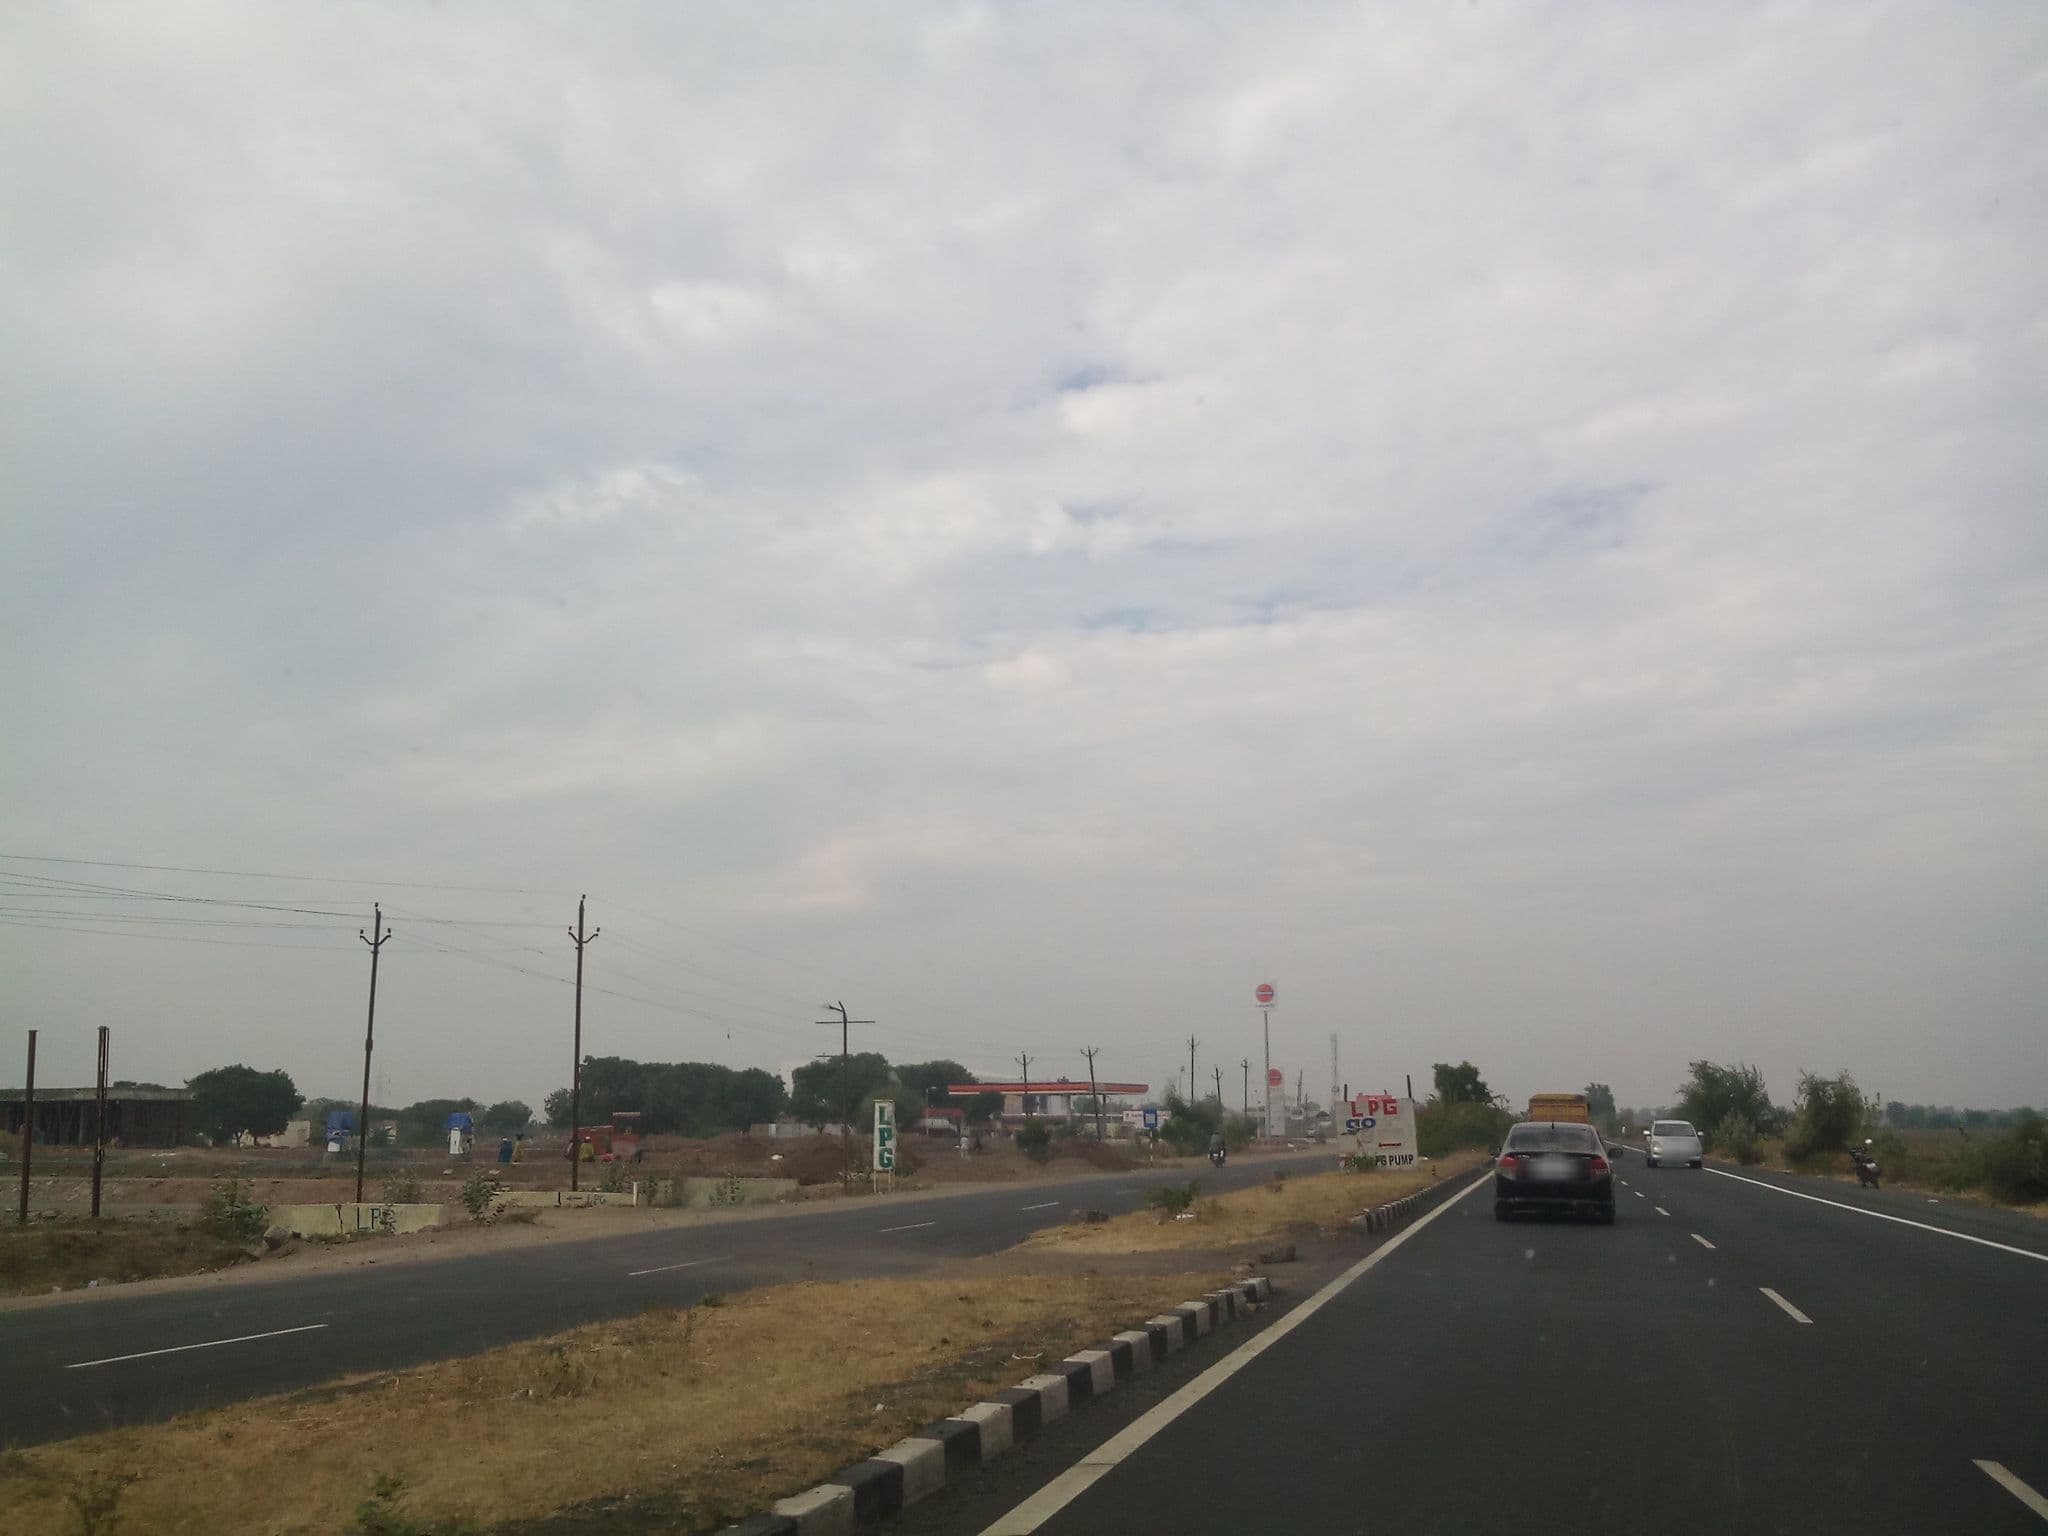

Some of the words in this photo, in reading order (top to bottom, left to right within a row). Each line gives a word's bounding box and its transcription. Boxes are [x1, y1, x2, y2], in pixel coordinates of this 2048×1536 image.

[1350, 1098, 1399, 1118] LPG
[878, 1105, 894, 1169] LPG
[1388, 1153, 1415, 1167] PUMP
